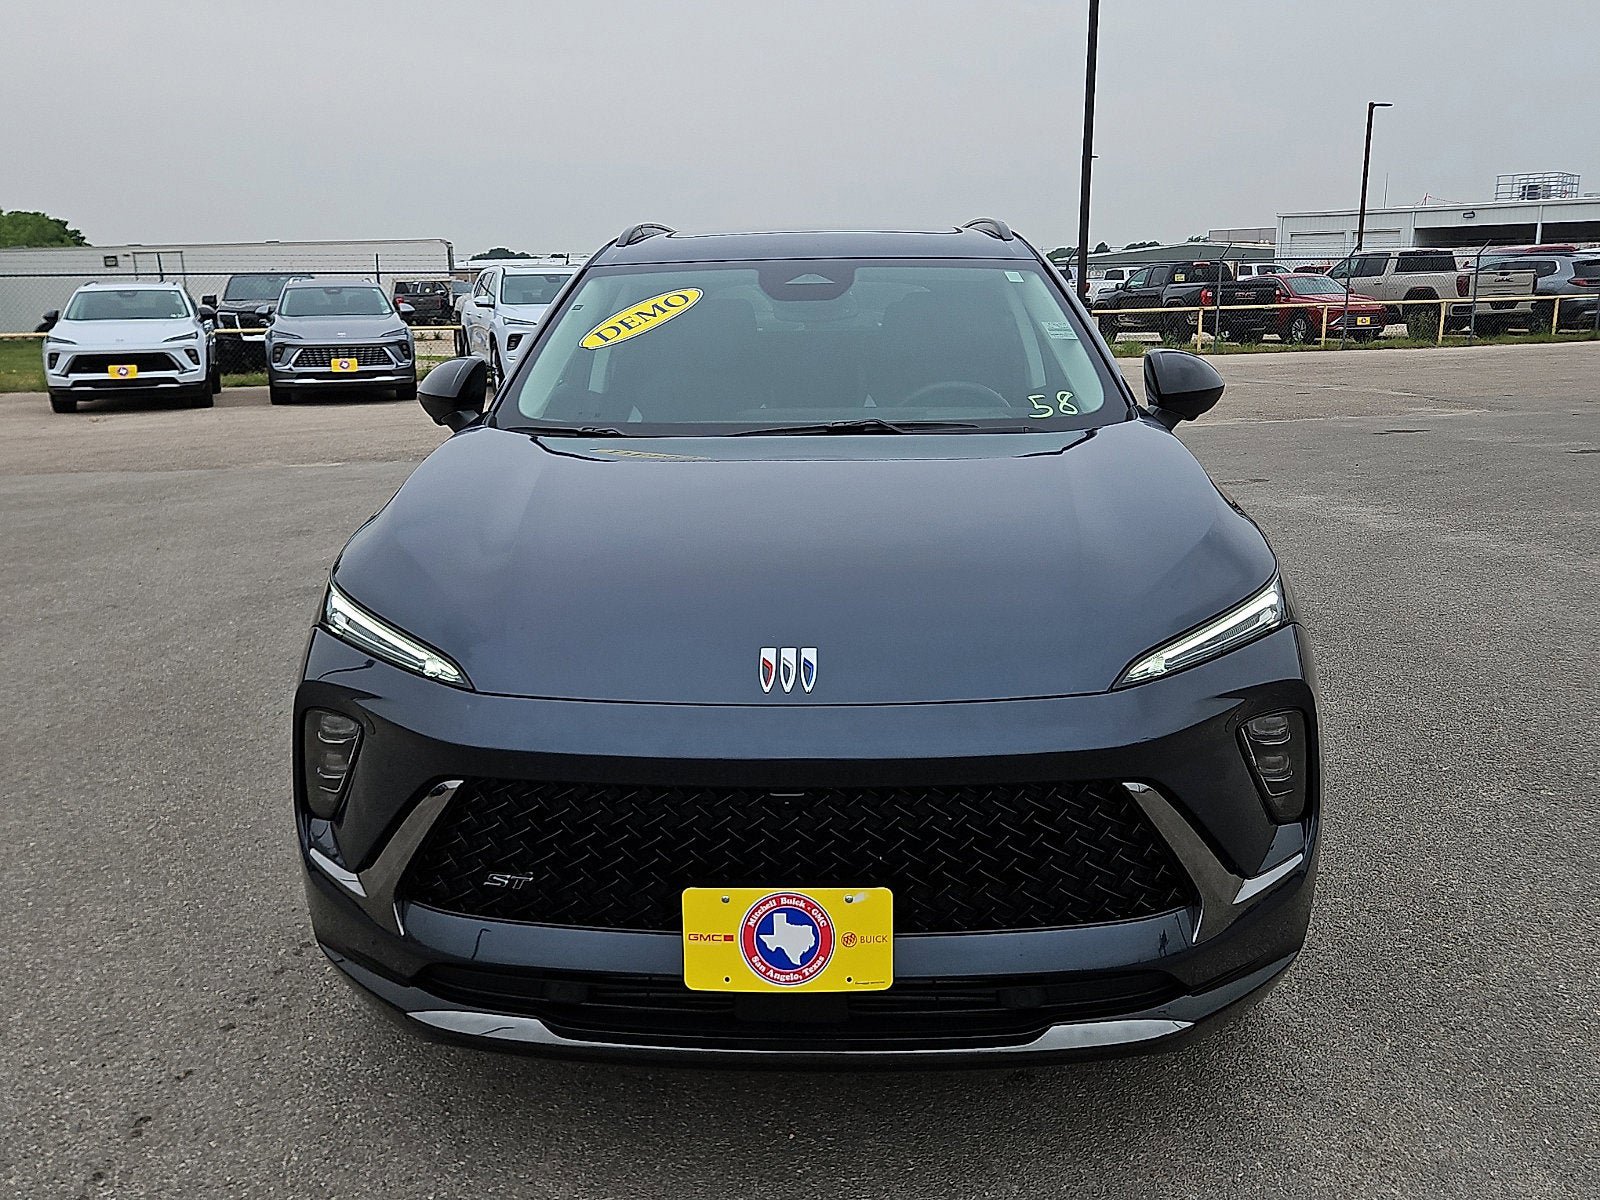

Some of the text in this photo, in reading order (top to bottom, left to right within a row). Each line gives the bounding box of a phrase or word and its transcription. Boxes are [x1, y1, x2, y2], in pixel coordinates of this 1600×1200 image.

[592, 294, 690, 343] DEMO
[1027, 390, 1079, 419] 58
[483, 872, 534, 890] ST
[747, 897, 828, 928] Mitchell Buick GMC
[688, 933, 722, 942] GMC
[860, 935, 888, 944] BUICK
[751, 955, 825, 982] San Angelo, Texas
